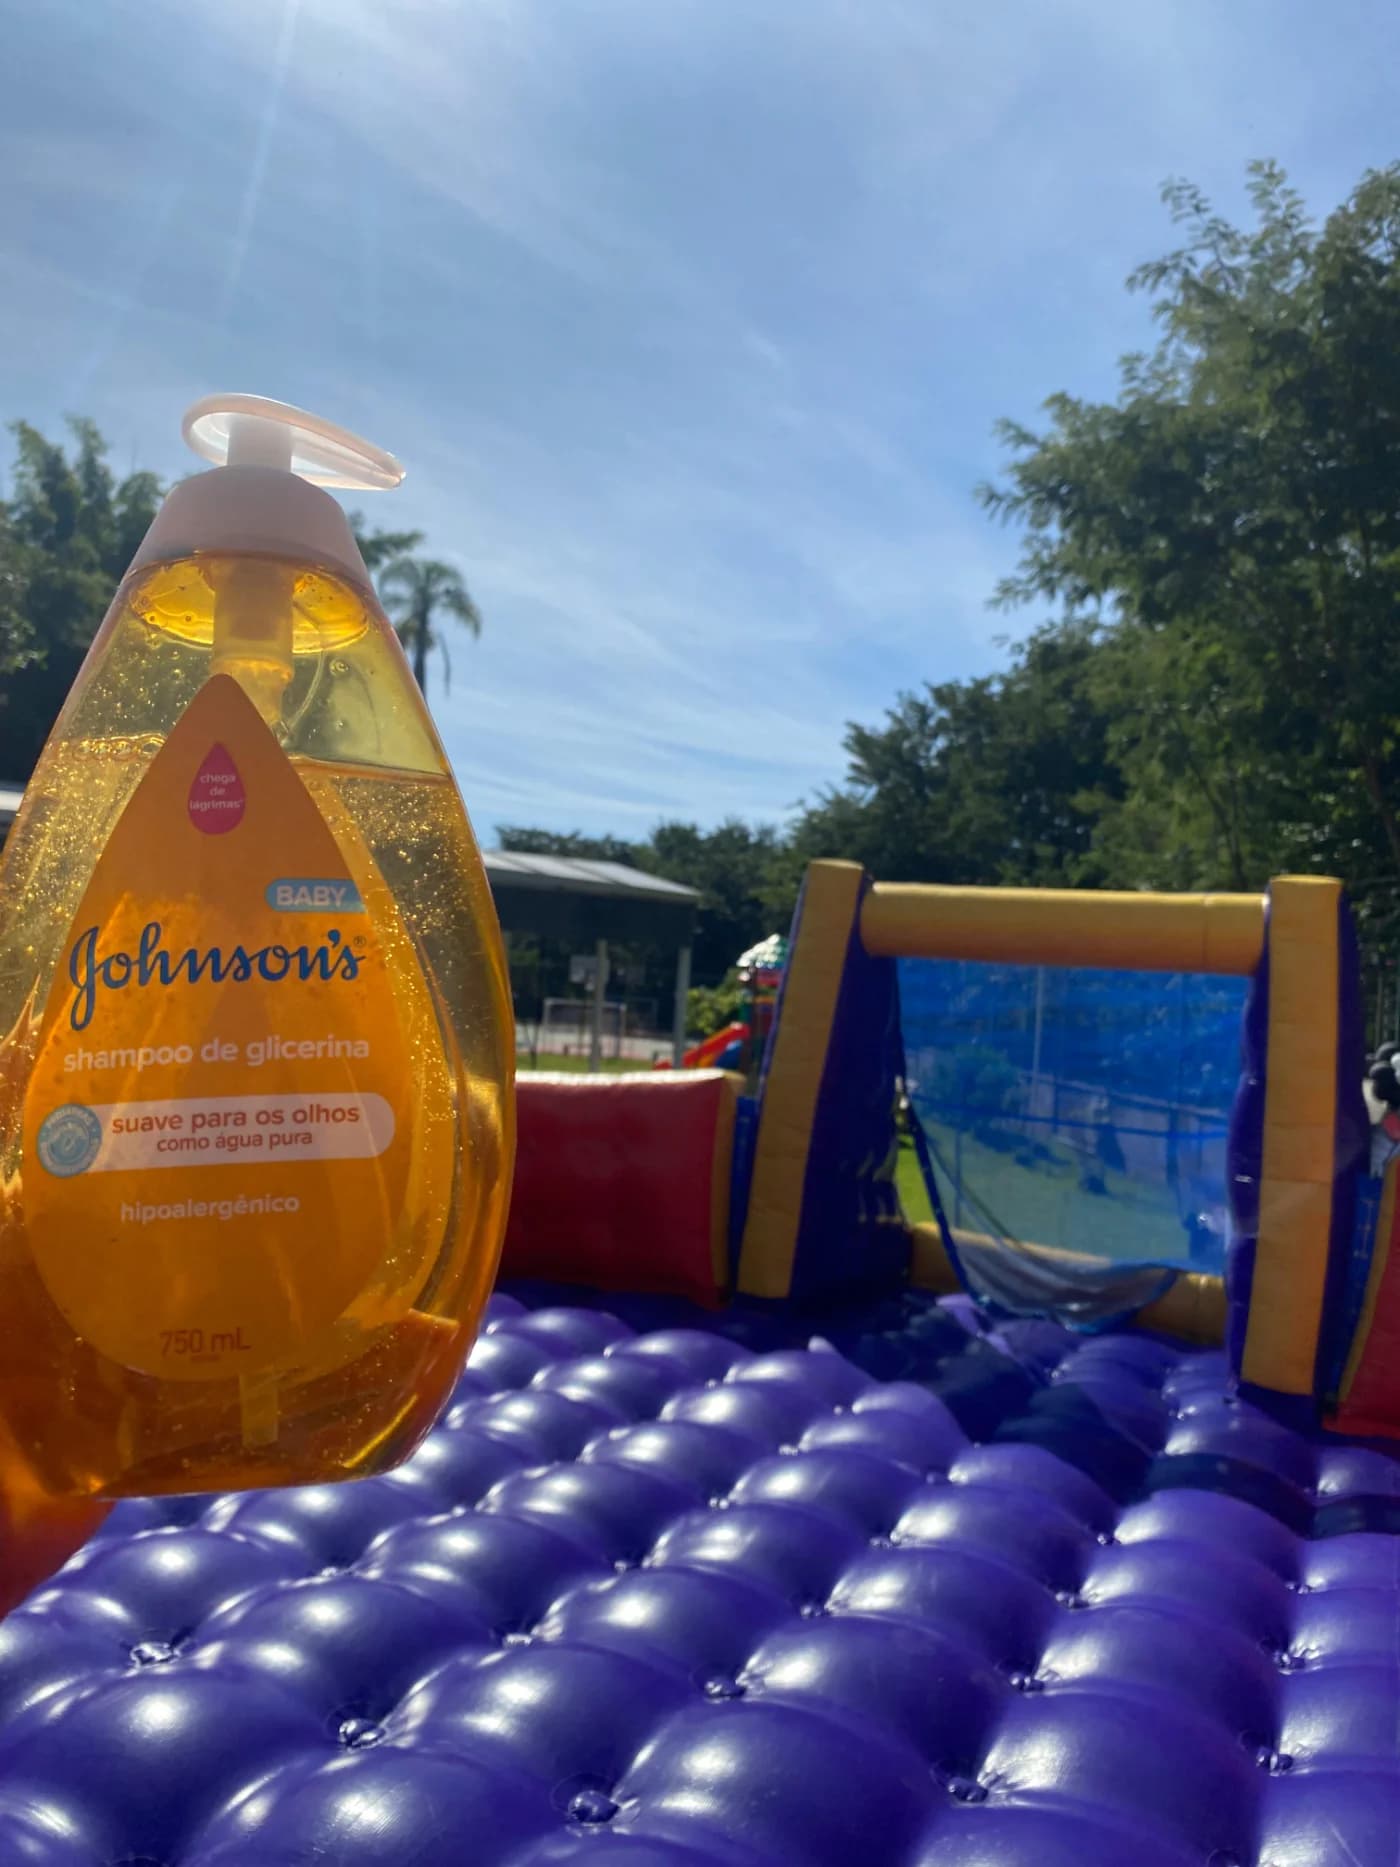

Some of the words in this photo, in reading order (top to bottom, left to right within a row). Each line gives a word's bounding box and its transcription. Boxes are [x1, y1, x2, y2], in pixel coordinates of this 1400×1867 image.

[209, 786, 226, 796] de
[276, 885, 347, 907] BABY
[63, 1043, 193, 1072] shampoo
[200, 1038, 238, 1062] de
[246, 1033, 369, 1067] glicerina
[112, 1114, 183, 1134] suave
[191, 1110, 247, 1133] para
[255, 1108, 285, 1126] os
[293, 1104, 361, 1124] olhos
[156, 1136, 210, 1152] como
[215, 1131, 263, 1152] água
[269, 1130, 313, 1150] pura
[120, 1194, 301, 1224] hipoalergênico
[159, 1329, 203, 1357] 750
[211, 1327, 252, 1352] mL
